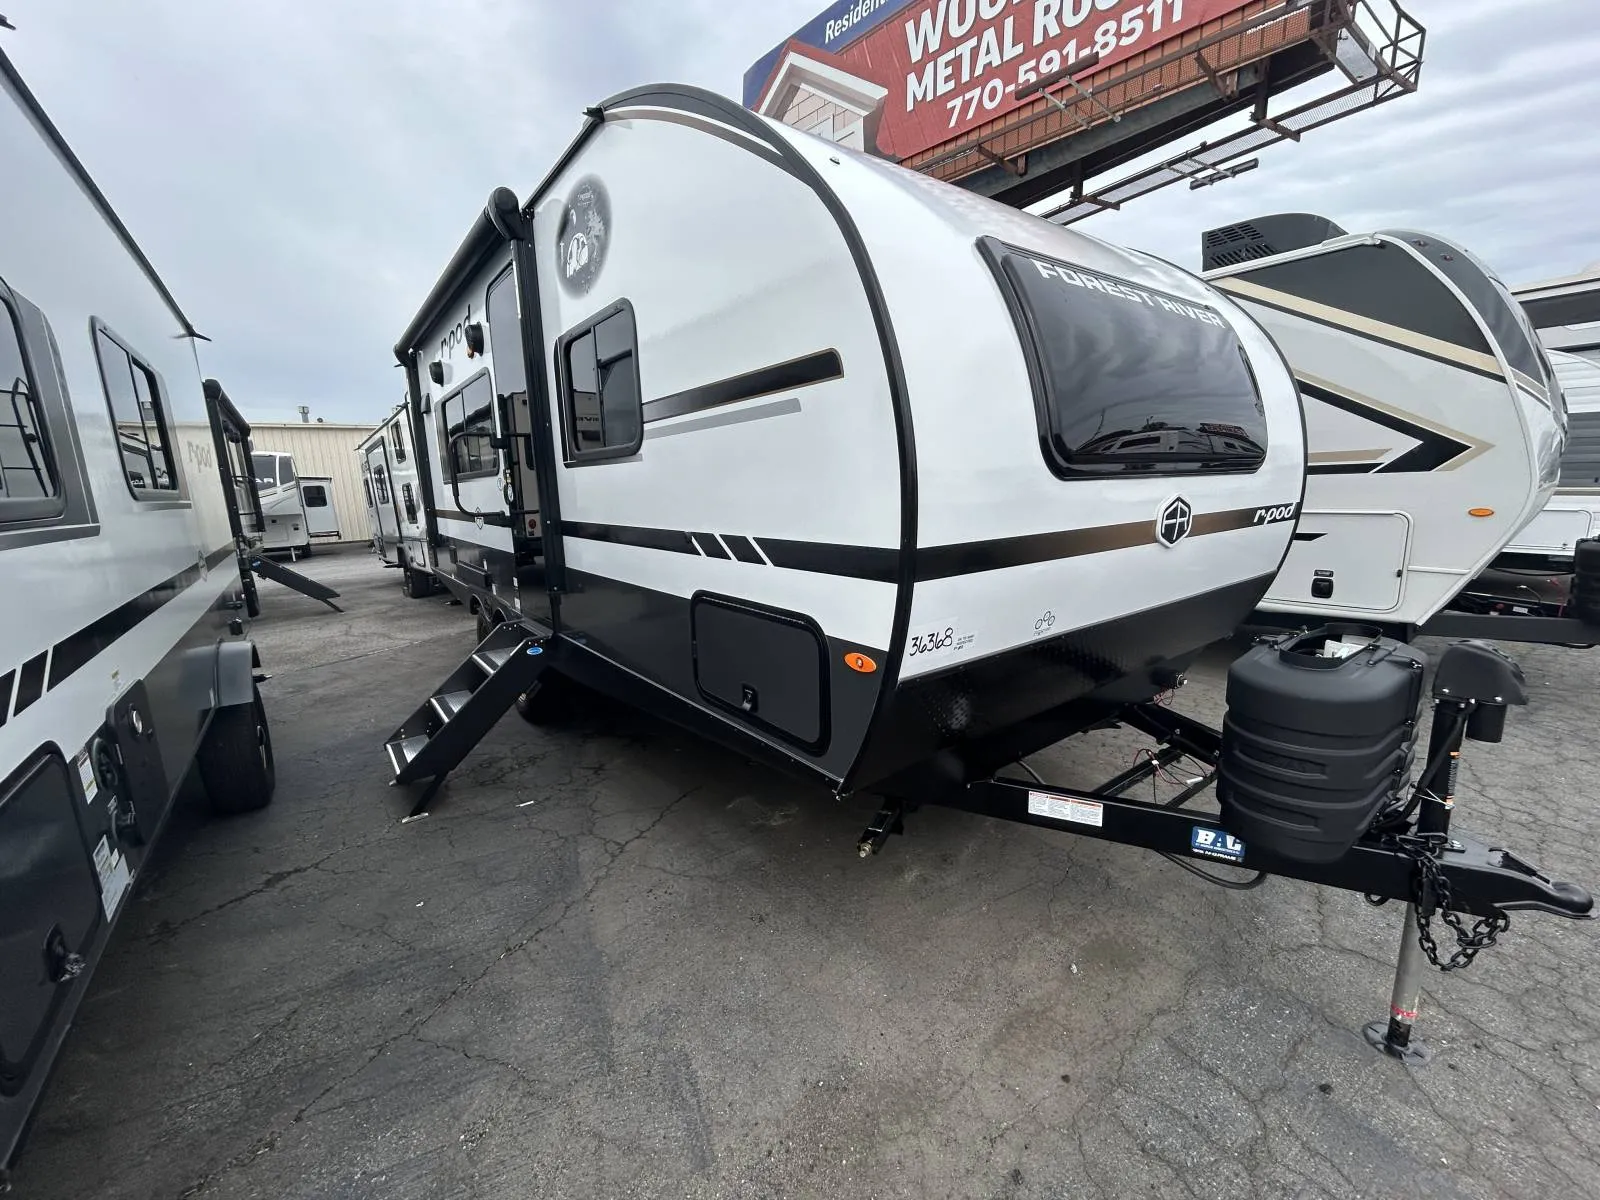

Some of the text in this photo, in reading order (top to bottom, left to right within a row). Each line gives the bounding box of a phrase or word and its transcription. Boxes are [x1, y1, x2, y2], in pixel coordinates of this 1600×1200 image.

[825, 0, 888, 44] Residen
[906, 15, 1023, 112] METAL
[946, 0, 1184, 129] 770-591-8511
[1031, 258, 1226, 329] FOREST RIVER
[909, 627, 953, 657] 36368
